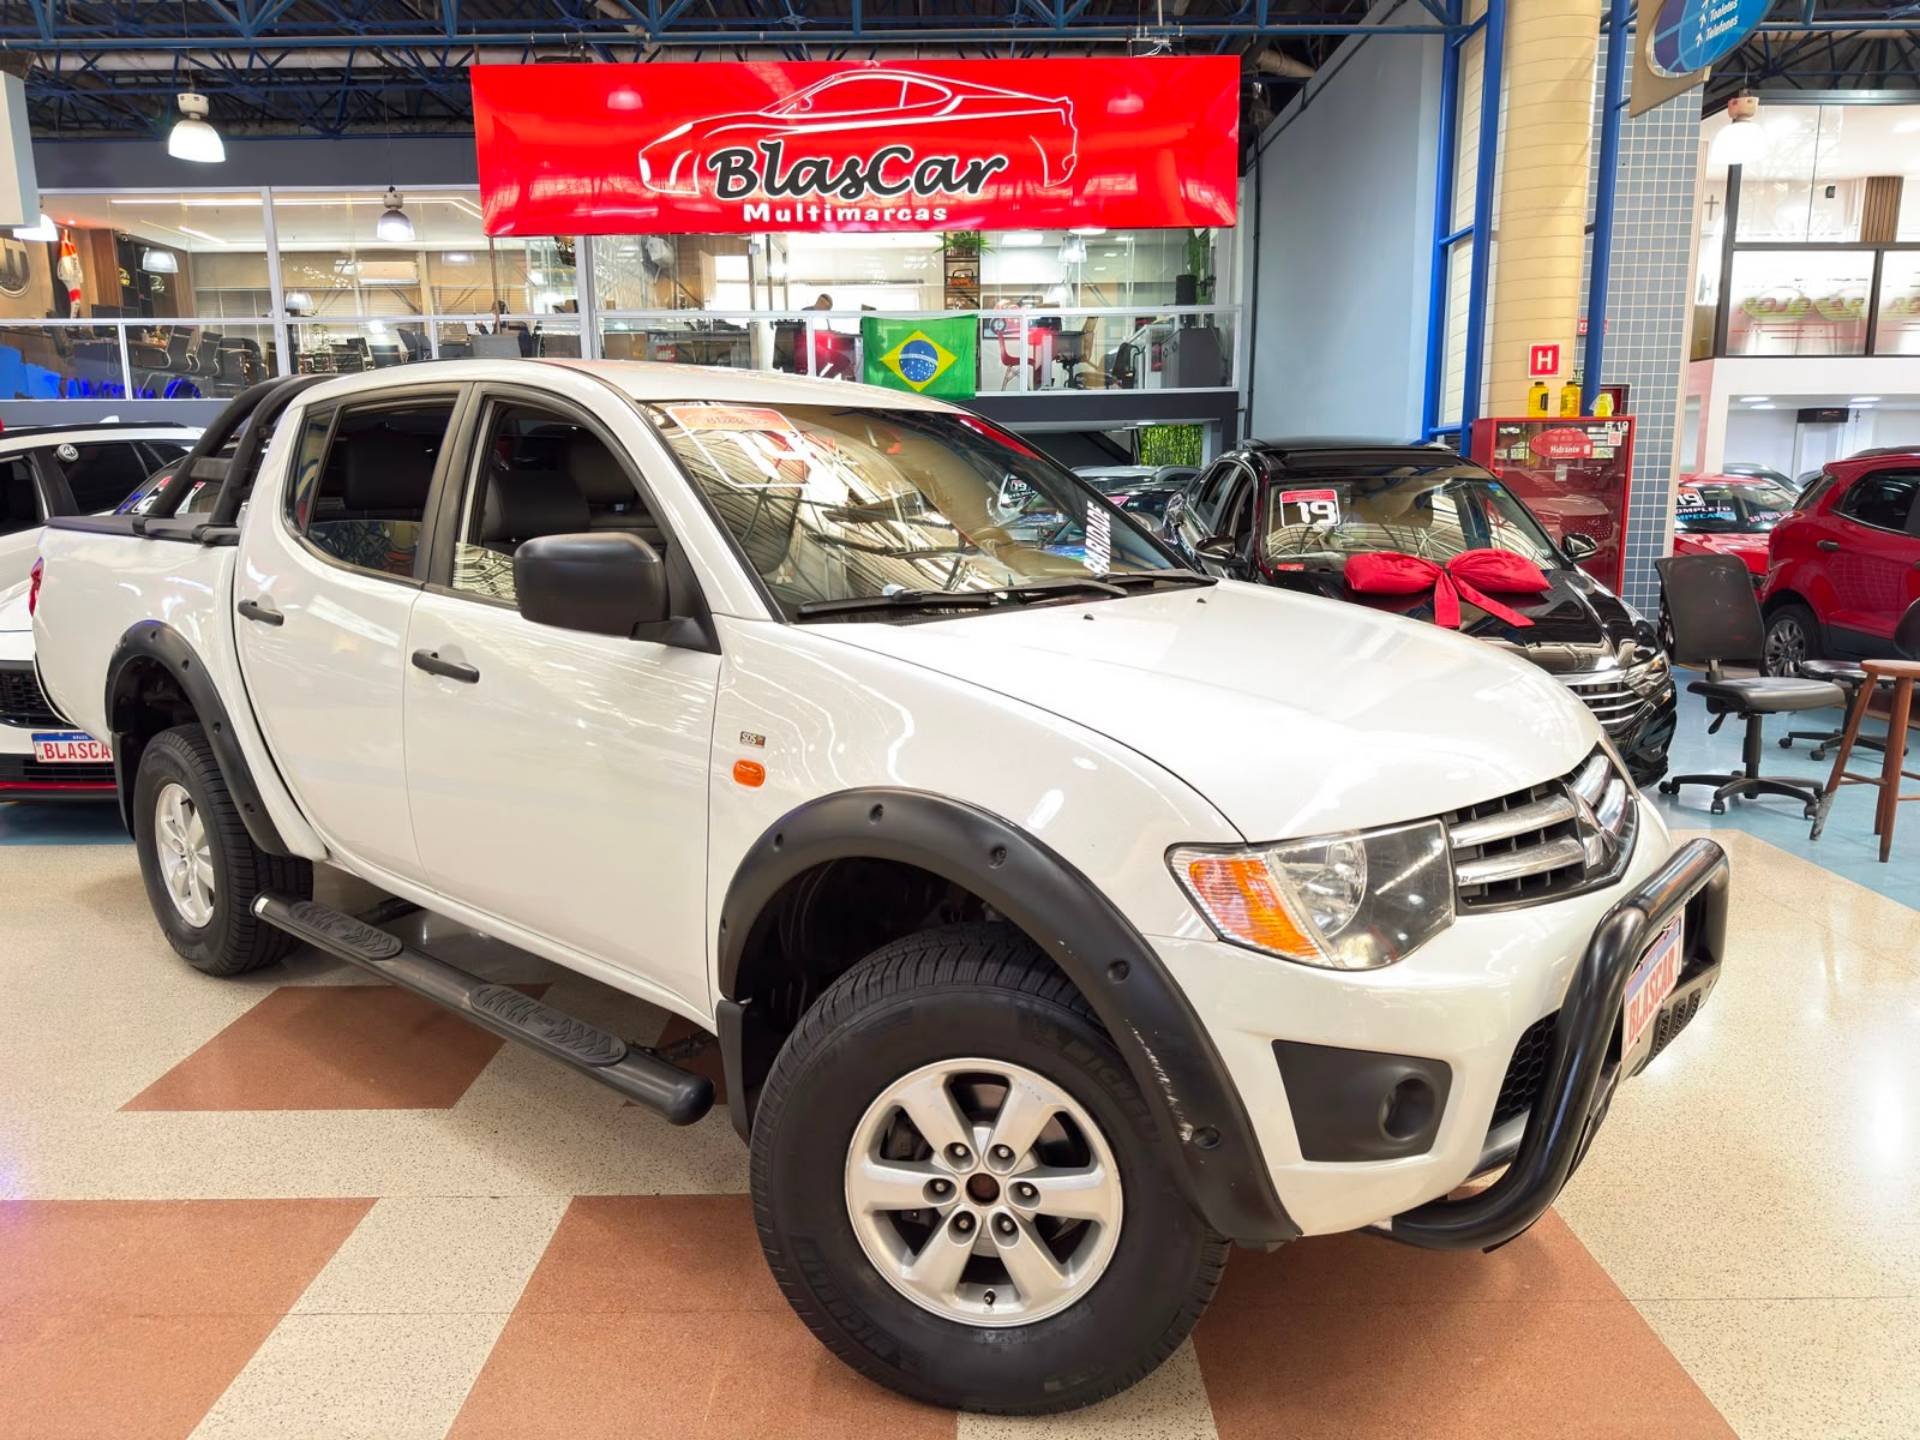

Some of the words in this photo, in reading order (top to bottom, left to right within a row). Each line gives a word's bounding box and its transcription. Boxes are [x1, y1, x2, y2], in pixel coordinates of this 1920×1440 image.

[707, 139, 1007, 200] BlasCar
[743, 203, 948, 223] Multimarcas
[1537, 351, 1553, 370] H
[1296, 501, 1338, 524] 19
[1675, 506, 1731, 514] OMPLETO
[43, 742, 111, 760] BLASCA
